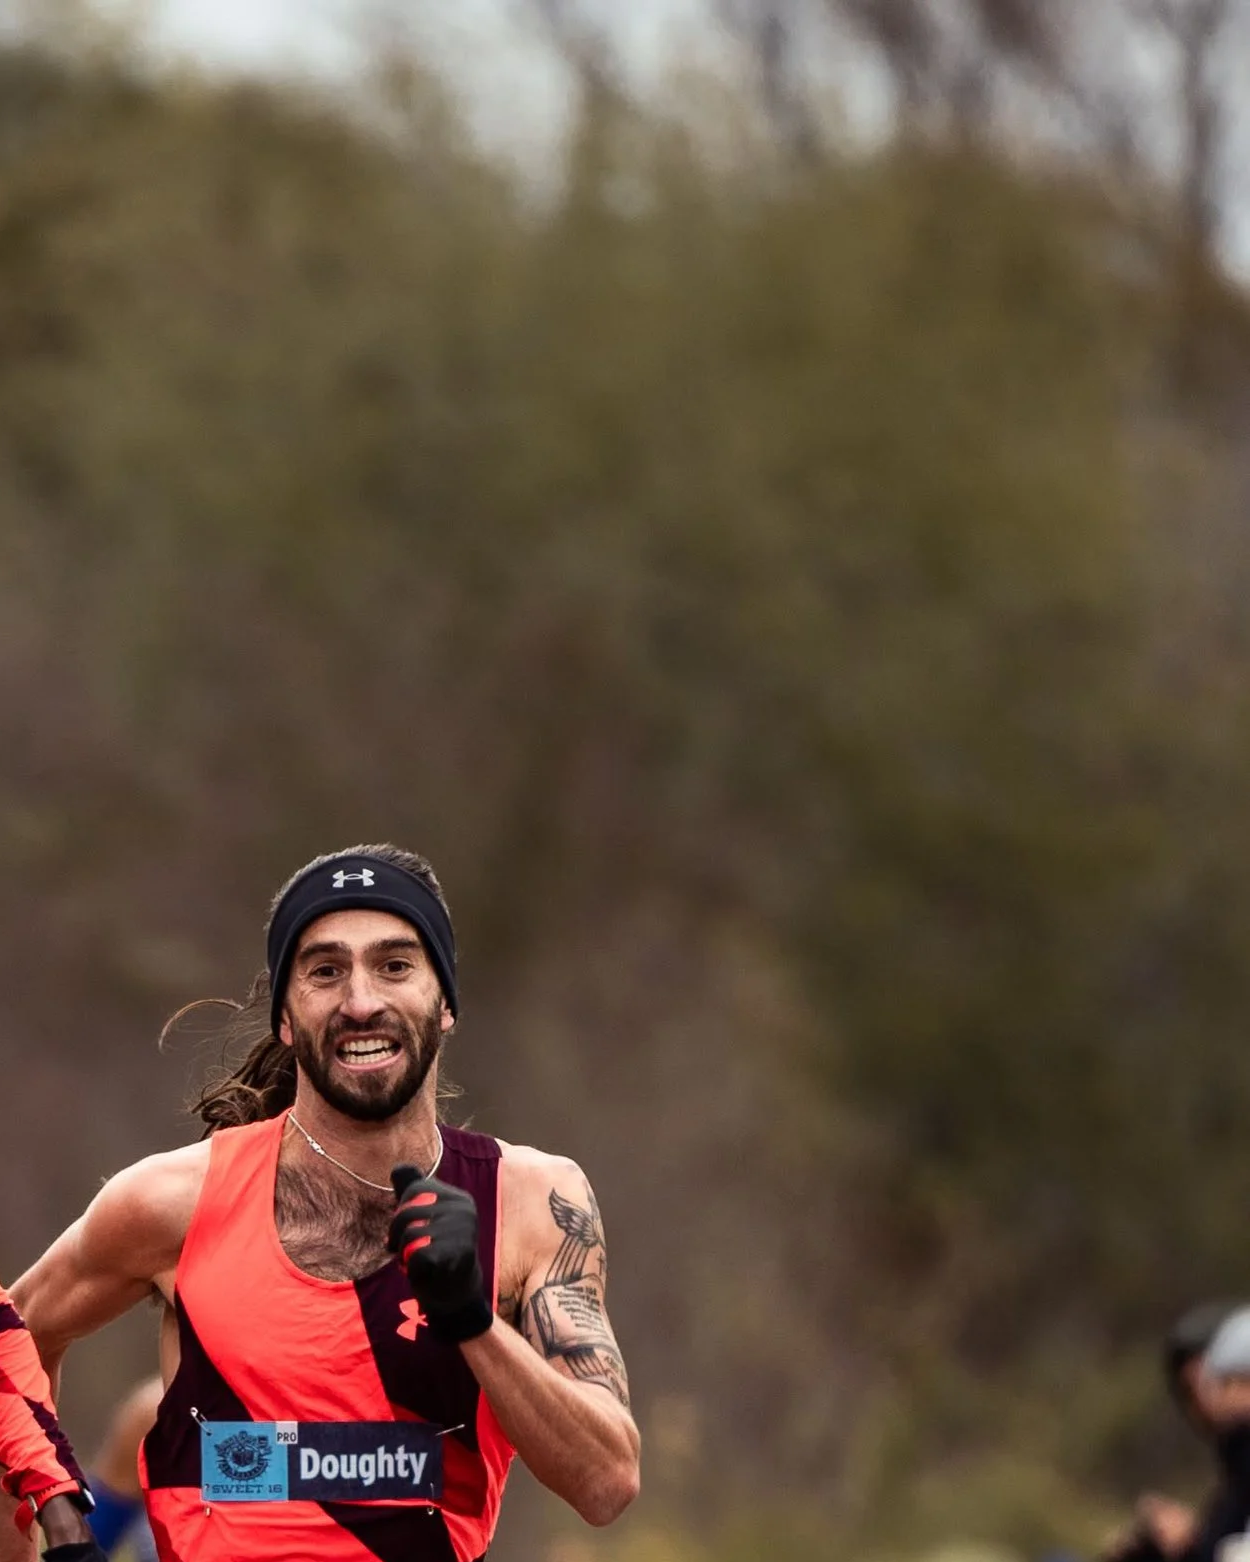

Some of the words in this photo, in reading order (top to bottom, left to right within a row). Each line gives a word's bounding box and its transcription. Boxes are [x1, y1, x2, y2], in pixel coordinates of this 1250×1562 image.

[277, 1432, 297, 1442] PRO
[300, 1444, 428, 1486] Doughty
[212, 1483, 263, 1494] SWEET
[268, 1483, 282, 1494] 16
